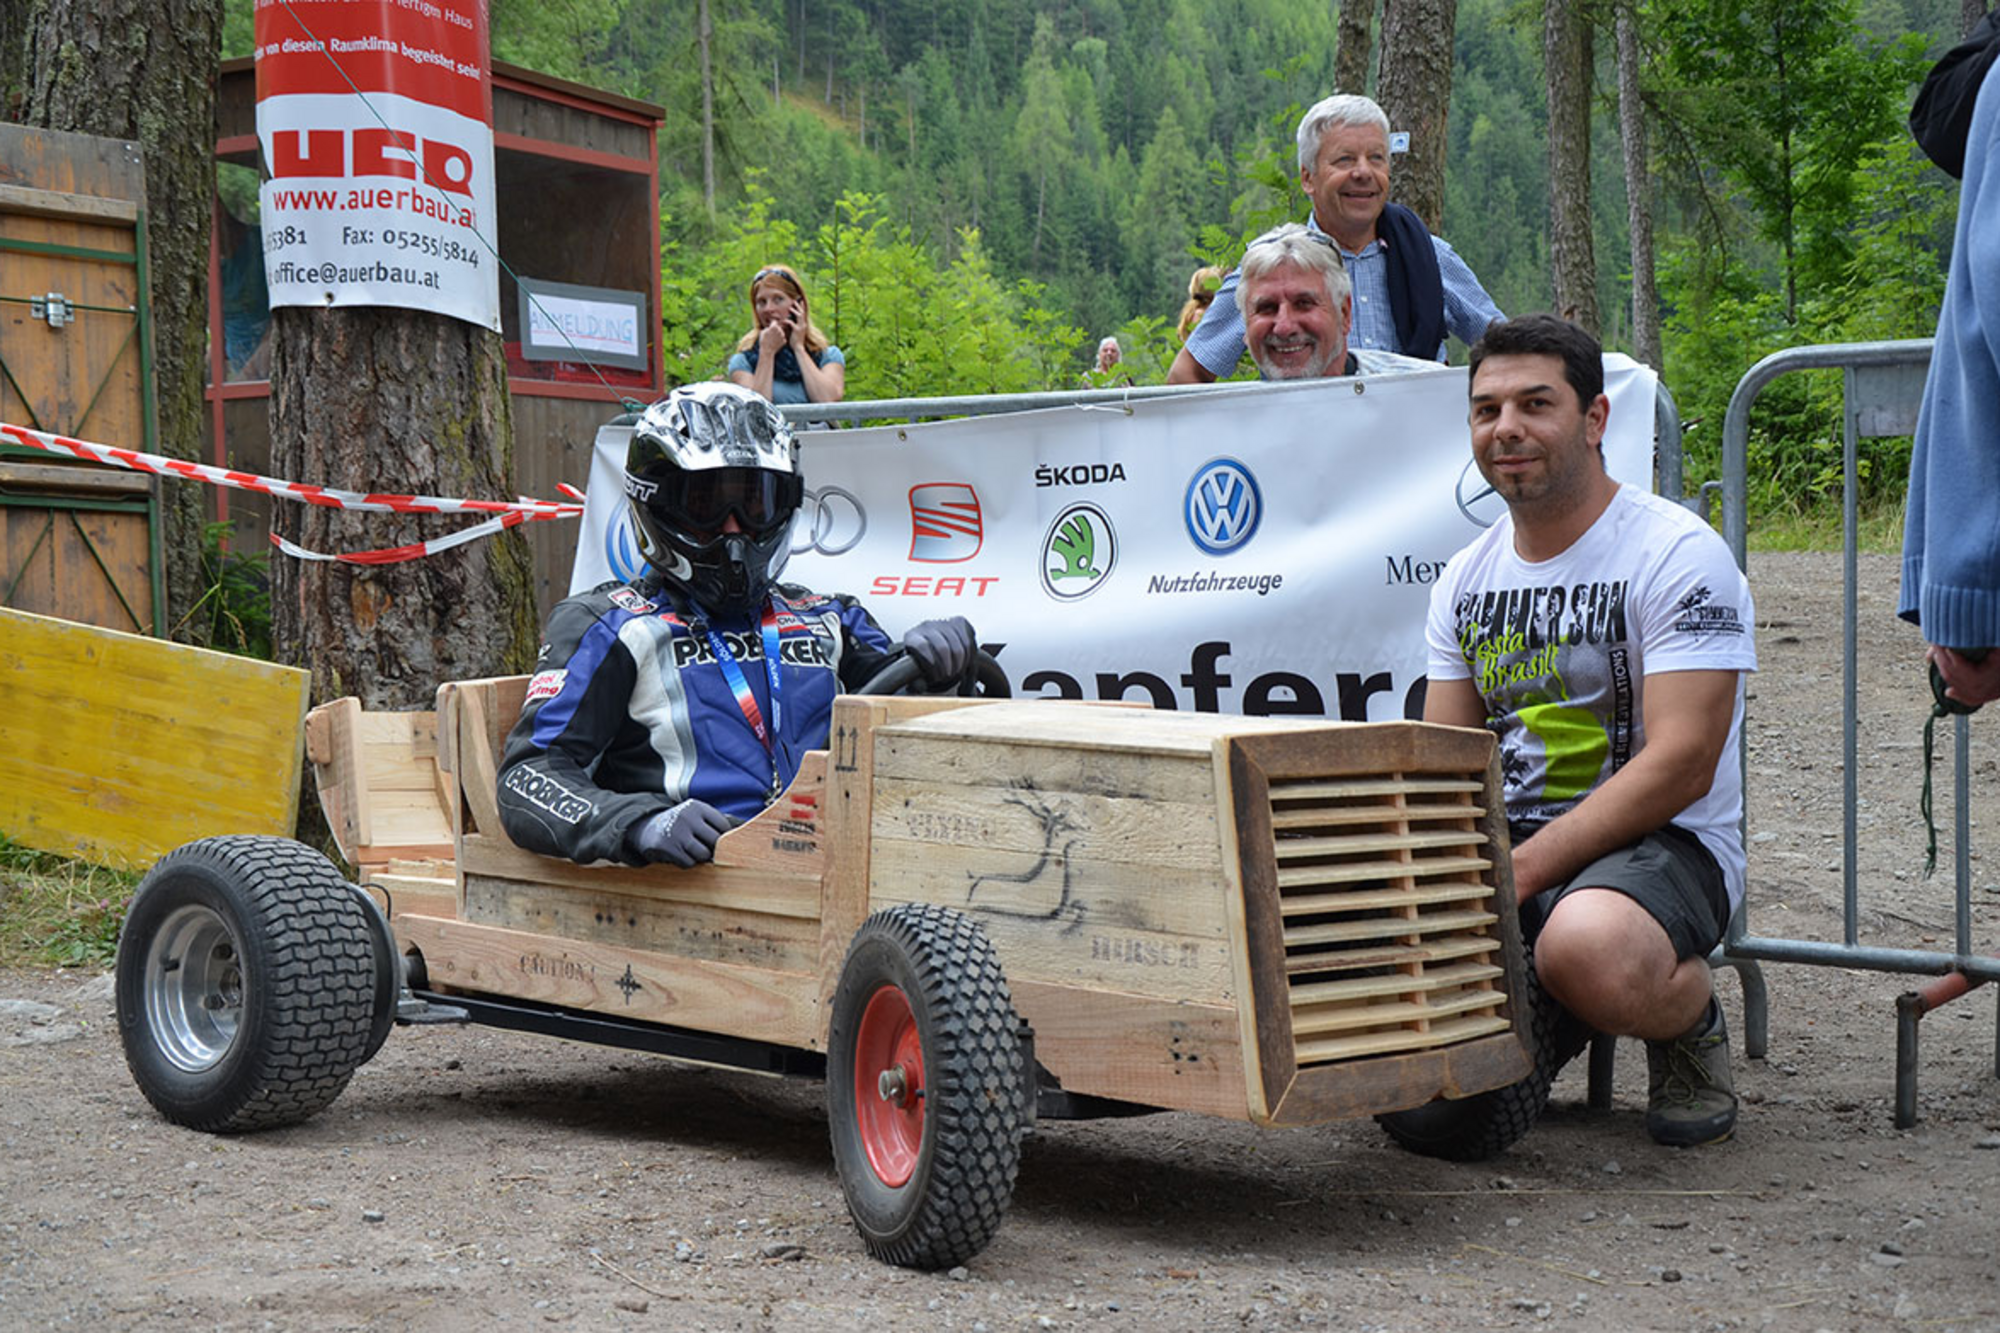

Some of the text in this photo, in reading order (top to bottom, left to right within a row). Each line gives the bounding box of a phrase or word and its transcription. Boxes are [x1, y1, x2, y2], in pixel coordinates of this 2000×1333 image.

[445, 8, 473, 30] Haus
[330, 36, 398, 53] Raumklima
[342, 226, 374, 246] Fax:
[383, 229, 479, 269] 05255/5814
[274, 261, 440, 290] office@auerbau.at
[1035, 463, 1127, 488] ŠKODA
[869, 577, 1000, 596] SEAT
[1147, 570, 1283, 596] Nutzfahrzeuge
[505, 764, 592, 825] PROBIKER
